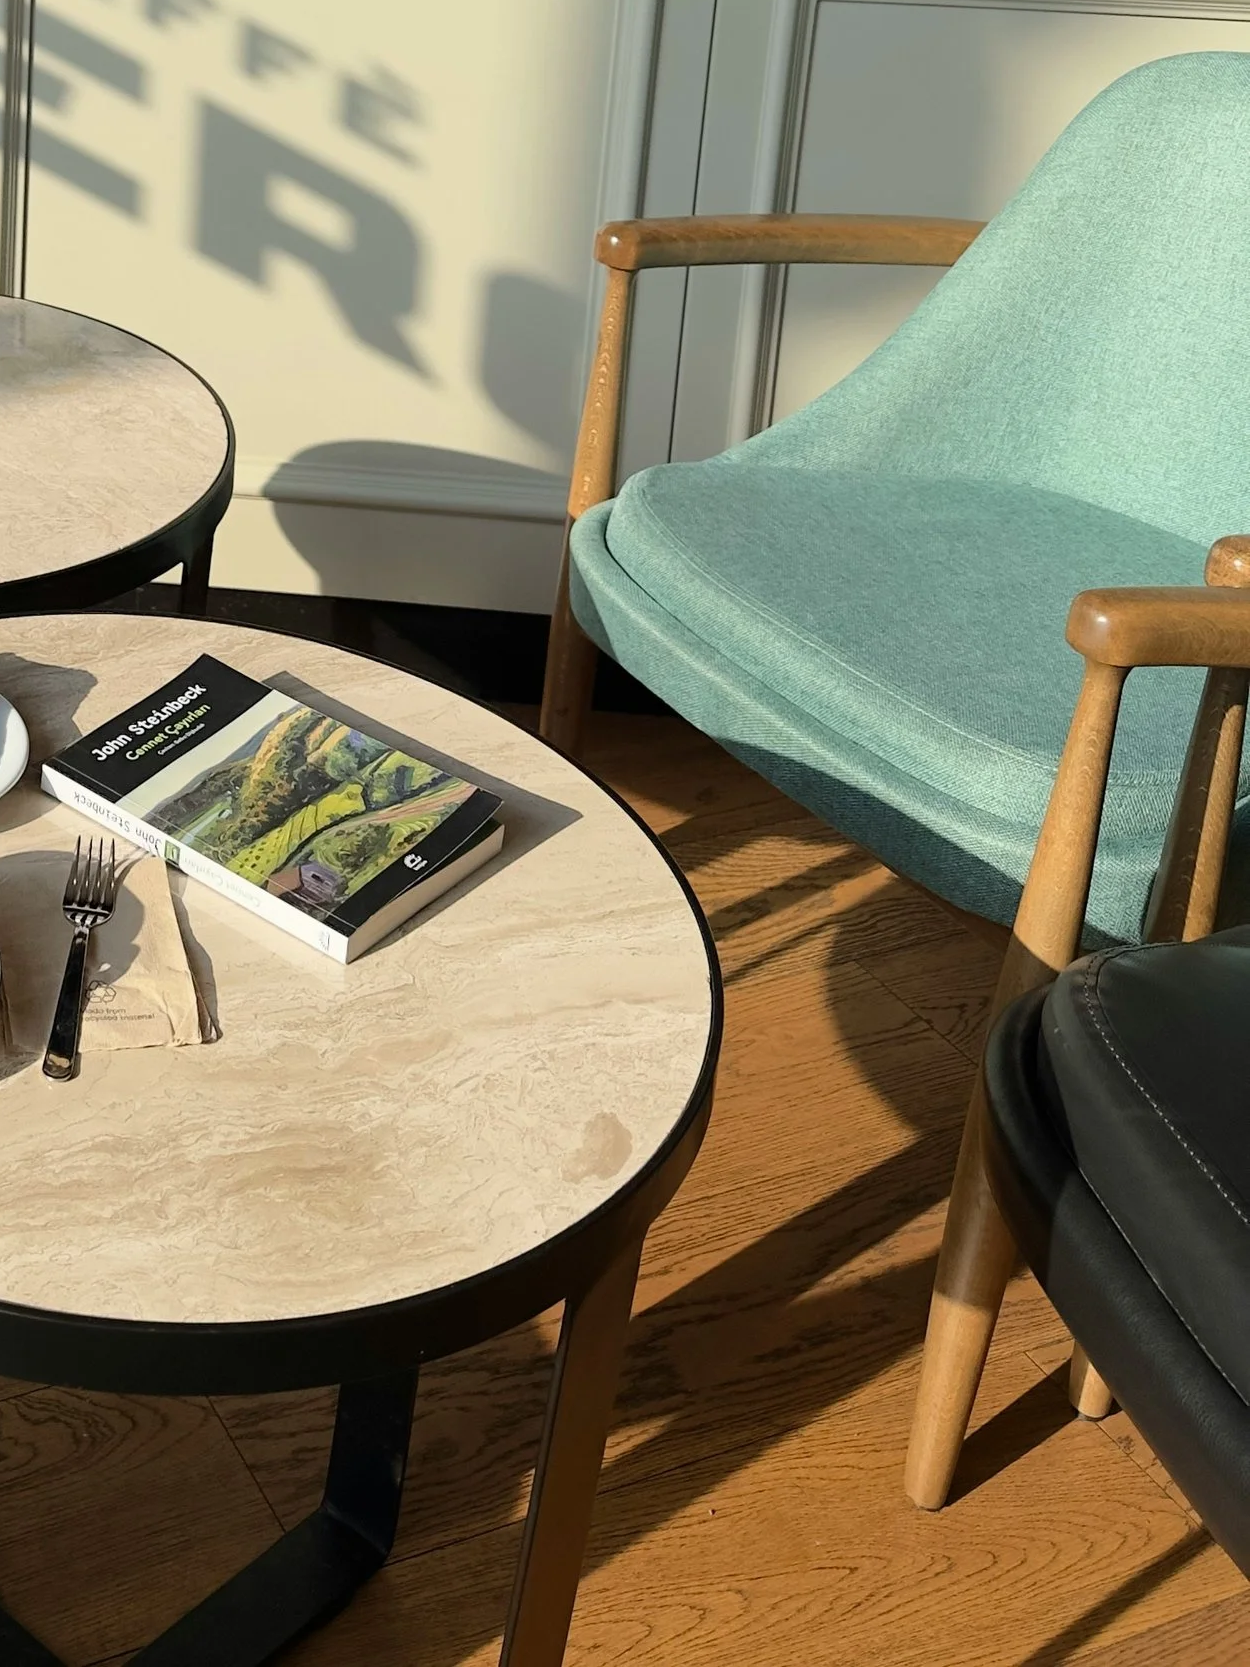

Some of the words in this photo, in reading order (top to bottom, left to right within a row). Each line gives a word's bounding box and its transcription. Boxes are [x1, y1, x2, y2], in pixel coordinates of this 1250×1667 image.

[91, 733, 133, 762] John
[128, 683, 208, 736] Steinbeck
[125, 732, 169, 761] Cennet
[72, 790, 131, 833] Steinbeck
[135, 826, 163, 851] John
